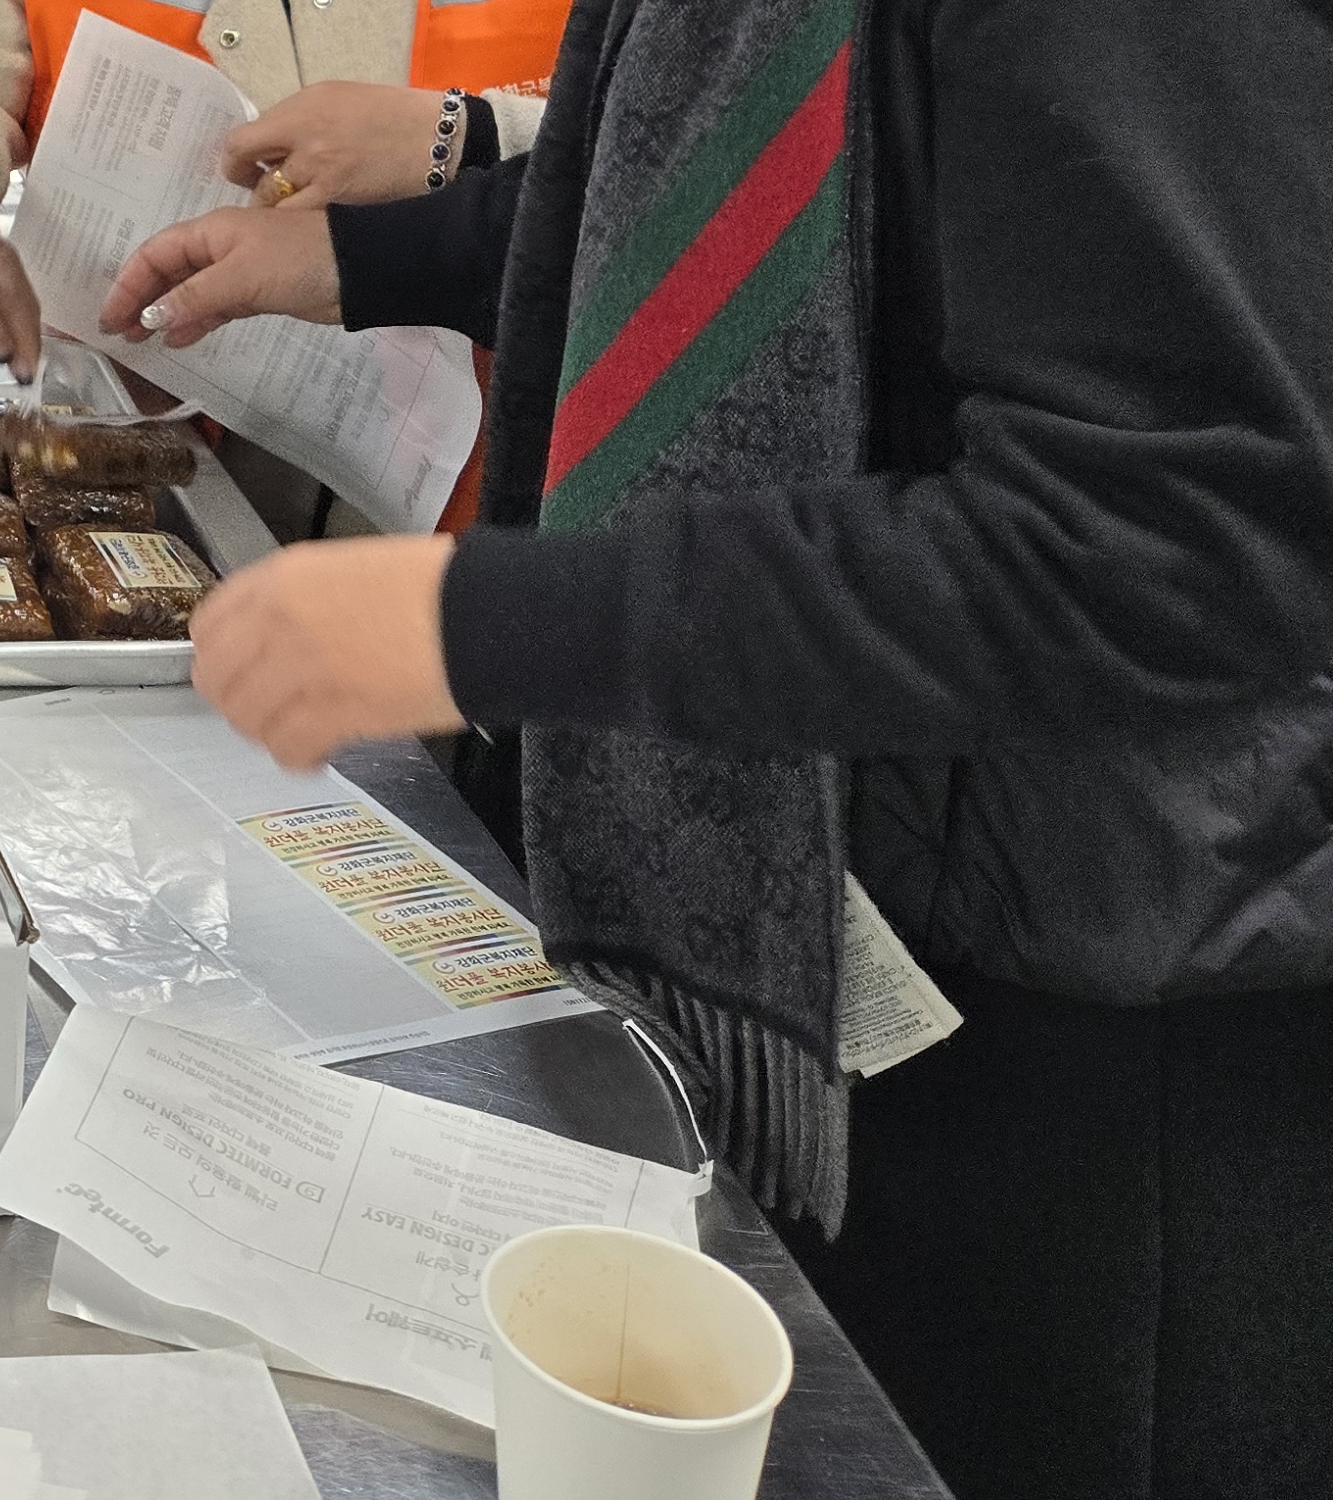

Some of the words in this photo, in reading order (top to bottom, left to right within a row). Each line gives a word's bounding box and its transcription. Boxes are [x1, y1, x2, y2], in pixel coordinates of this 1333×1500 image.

[283, 806, 361, 827] 강화군복지재단
[312, 815, 388, 838] 복지봉사단
[338, 849, 417, 871] 강화군복지재단
[318, 873, 370, 893] 원더풀
[367, 859, 446, 883] 복지봉사단
[394, 896, 476, 918] 강화군복지재단
[375, 920, 427, 942] 원더풀
[426, 905, 505, 930] 복지봉사단
[454, 945, 537, 968] 강화군복지재단
[435, 970, 489, 993] 원더풀
[487, 958, 553, 981] 복지봉사
[155, 1051, 186, 1073] 디자인
[121, 1086, 157, 1111] PRO
[180, 1102, 207, 1123] 프로
[140, 1120, 162, 1140] 것
[156, 1106, 216, 1147] DESIGN
[207, 1115, 245, 1142] 디자인
[264, 1120, 284, 1136] 프로
[160, 1132, 196, 1160] 모든
[245, 1135, 272, 1156] 폼텍
[284, 1131, 314, 1151] 디자인
[192, 1154, 246, 1192] 활용의
[215, 1140, 292, 1189] FORMTEC
[242, 1183, 280, 1212] 라벨
[61, 1180, 171, 1260] Formtec
[360, 1205, 406, 1229] EASY
[431, 1209, 460, 1227] 이지
[409, 1220, 475, 1252] DESIGN
[462, 1220, 502, 1240] 디자인
[414, 1250, 470, 1278] 손쉽게
[362, 1302, 480, 1352] 소프트웨어
